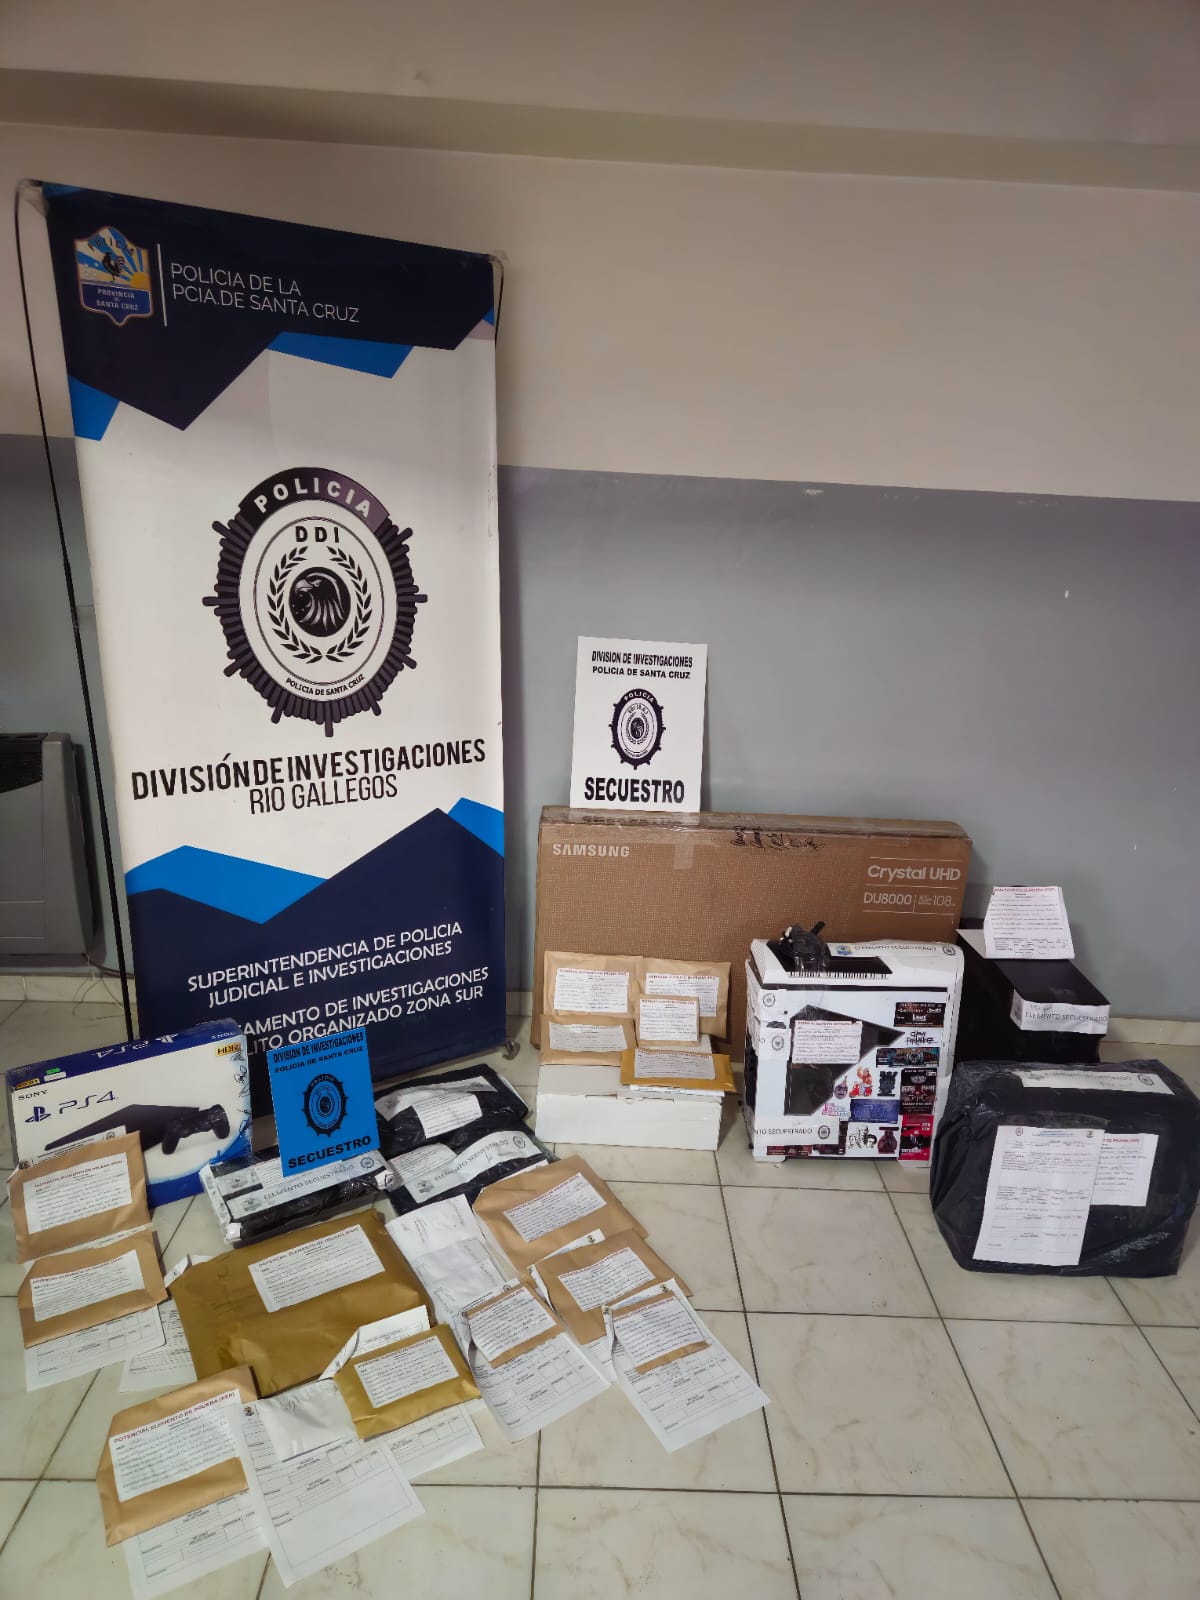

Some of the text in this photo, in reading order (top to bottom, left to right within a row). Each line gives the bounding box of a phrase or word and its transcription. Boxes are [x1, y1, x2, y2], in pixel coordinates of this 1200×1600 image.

[171, 262, 301, 297] POLICIA DE LA
[250, 294, 309, 317] SANTA
[312, 302, 360, 323] CRUZ
[254, 477, 371, 518] POLICIA
[295, 525, 340, 543] DDI
[592, 651, 693, 668] DIVISION DE INVESTIGACIONES
[592, 666, 691, 679] POLICIA DE SANTA CRUZ
[285, 673, 365, 696] POLICIA DE SANTA CRUZ
[623, 691, 654, 703] POLICIA
[131, 738, 485, 800] DIVISIÓN DE INVESTIGACIONES
[249, 773, 398, 815] RIO GALLEGOS
[584, 776, 685, 804] SECUESTRO
[552, 843, 630, 857] SAMSUNG
[867, 865, 961, 883] Crystal UHD
[863, 892, 912, 905] DU8000
[187, 922, 463, 992] SUPERINTENDENCIA DE POLICIA
[209, 940, 452, 1008] JUDICIAL E INVESTIGACIONES
[242, 966, 489, 1035] AMENTO DE INVESTIGACIONES
[288, 1004, 403, 1044] ORGANIZADO
[406, 993, 451, 1015] ZONA
[455, 985, 483, 1003] SUR
[217, 1044, 239, 1055] HDR
[273, 1032, 364, 1063] DIVISION DE INVESTIGACIONES
[274, 1061, 305, 1073] POLICIA
[319, 1052, 343, 1062] SANTA
[344, 1045, 363, 1055] CRUZ
[18, 1089, 49, 1101] SONY
[58, 1090, 116, 1115] PS4
[288, 1135, 372, 1169] SECUESTRO
